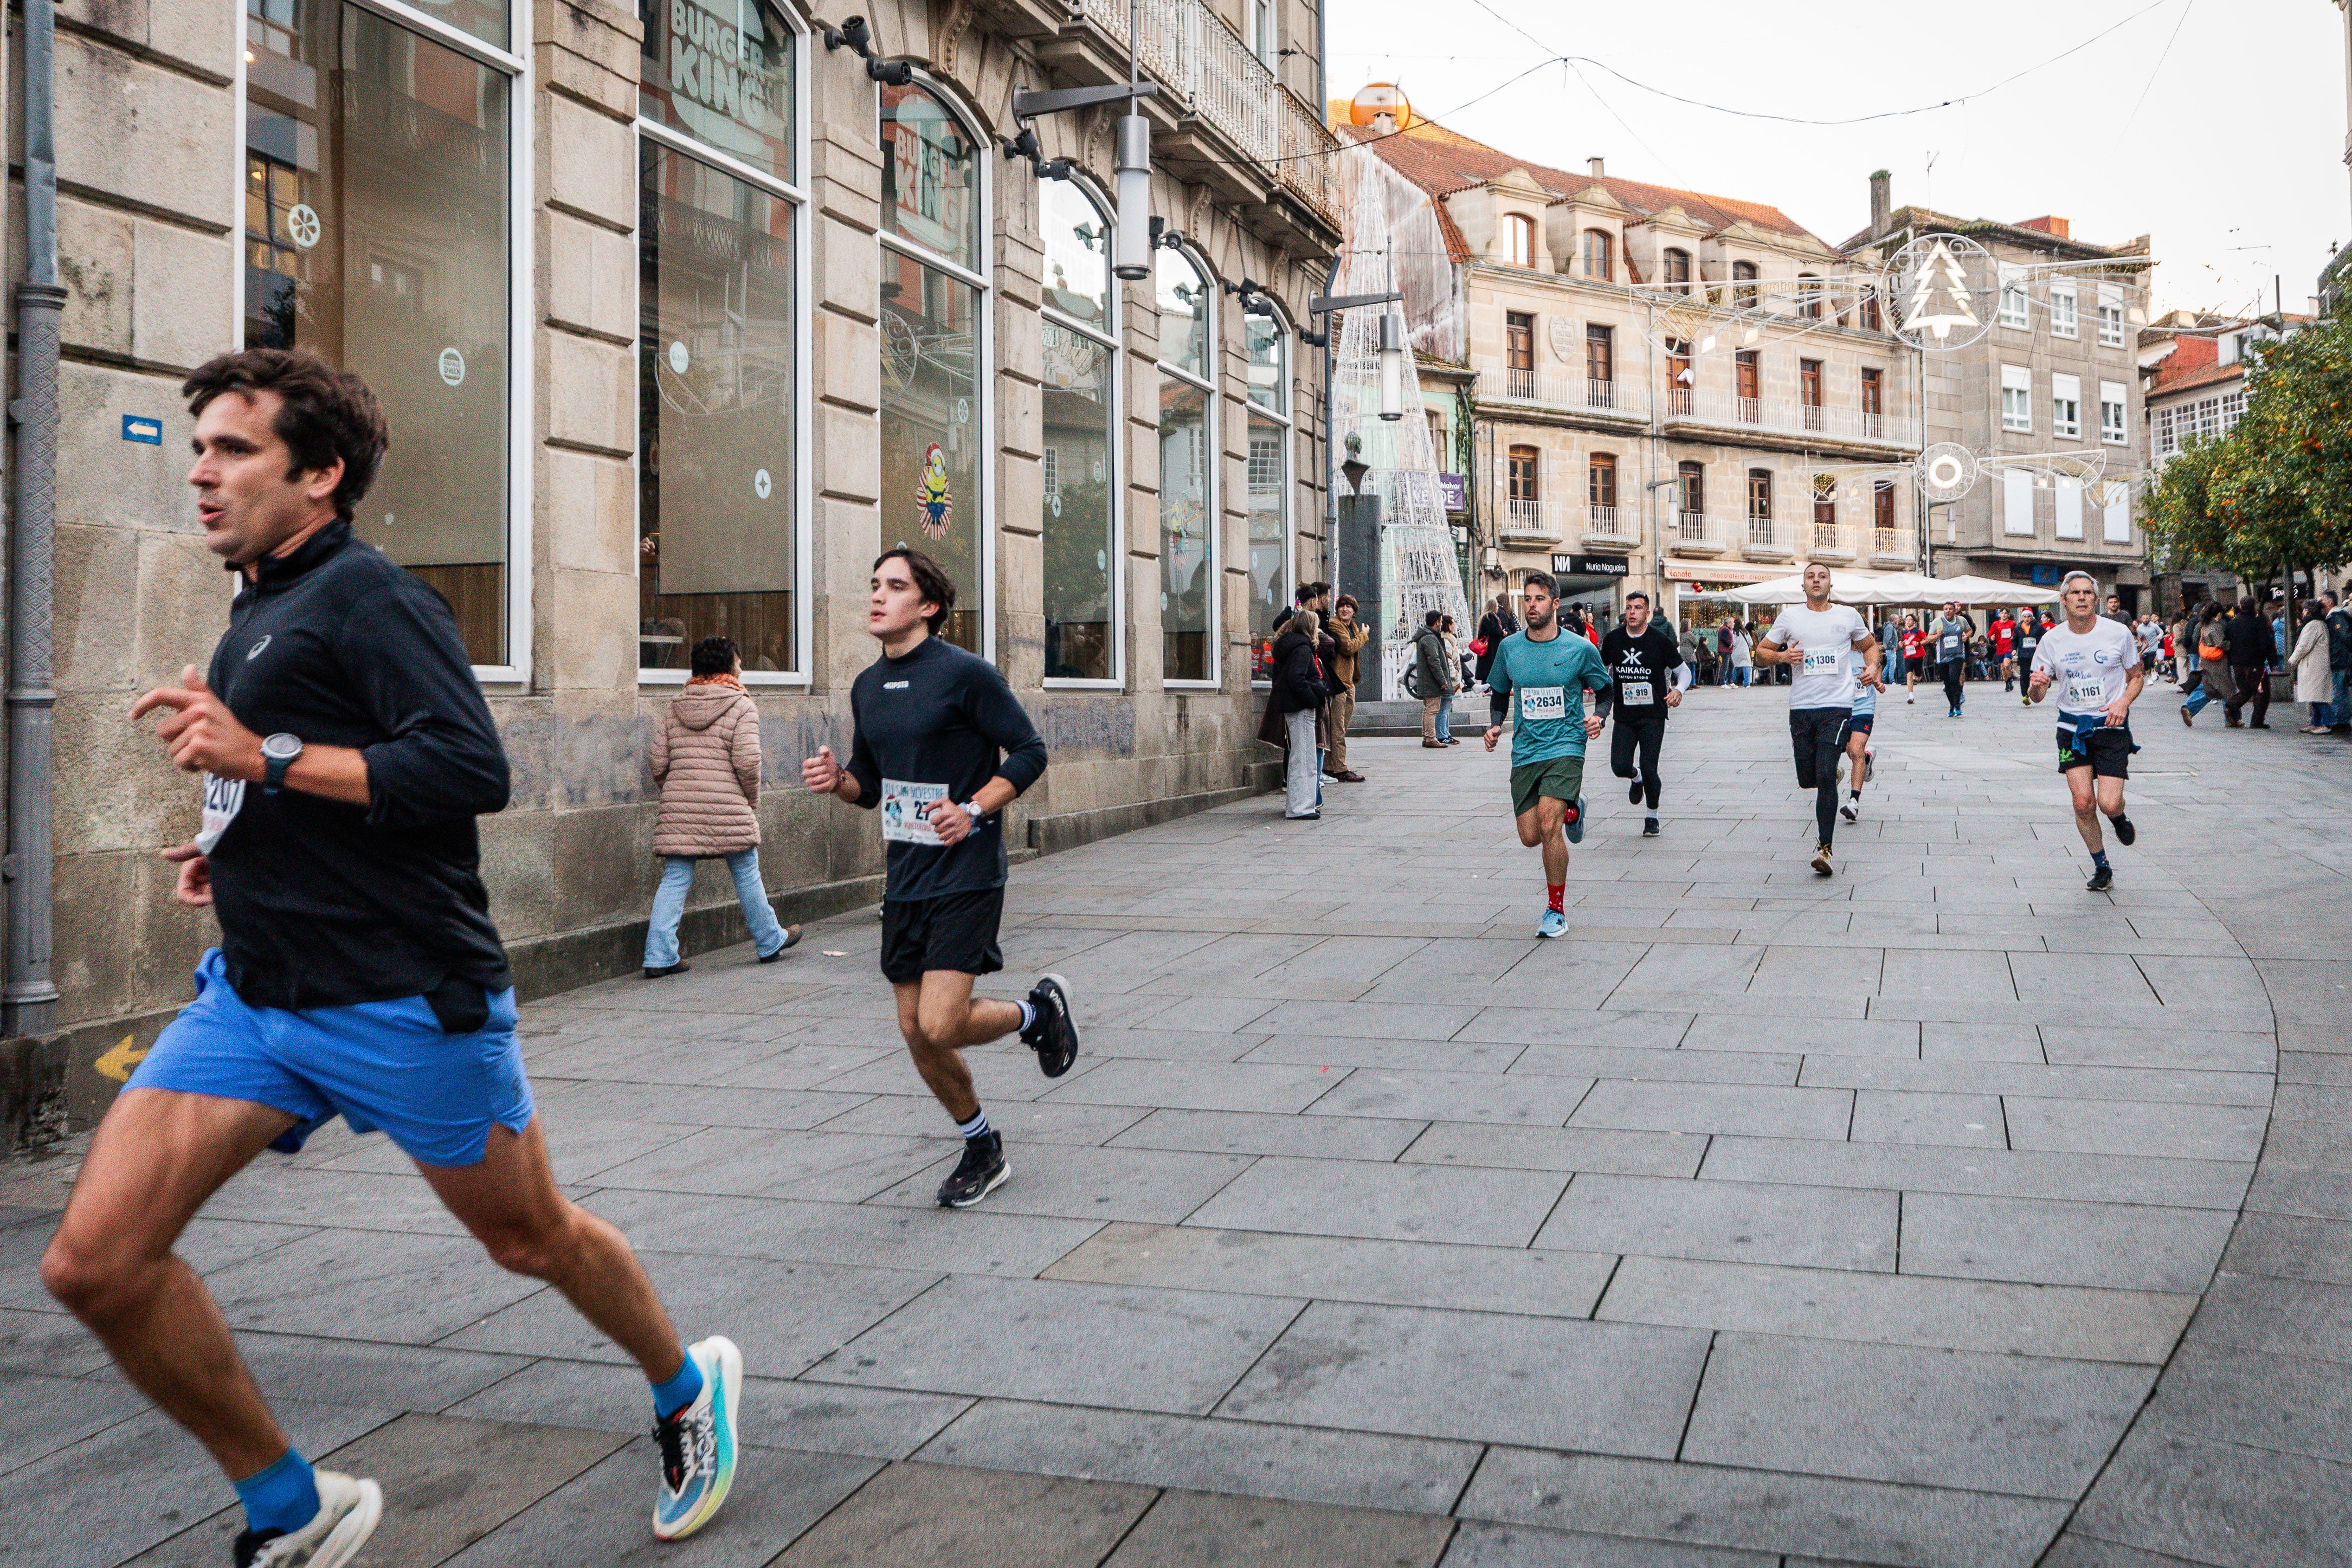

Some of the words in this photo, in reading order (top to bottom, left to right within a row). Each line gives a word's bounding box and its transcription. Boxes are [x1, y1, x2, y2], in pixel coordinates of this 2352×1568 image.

[671, 0, 764, 81] BURGER
[671, 35, 768, 129] KING
[1586, 562, 1601, 570] Nuria
[1602, 562, 1626, 573] Nogueira
[1816, 655, 1836, 665] 1306
[2081, 685, 2100, 697] 1161
[1536, 696, 1562, 707] 2634
[910, 785, 943, 800] SILVESTRE
